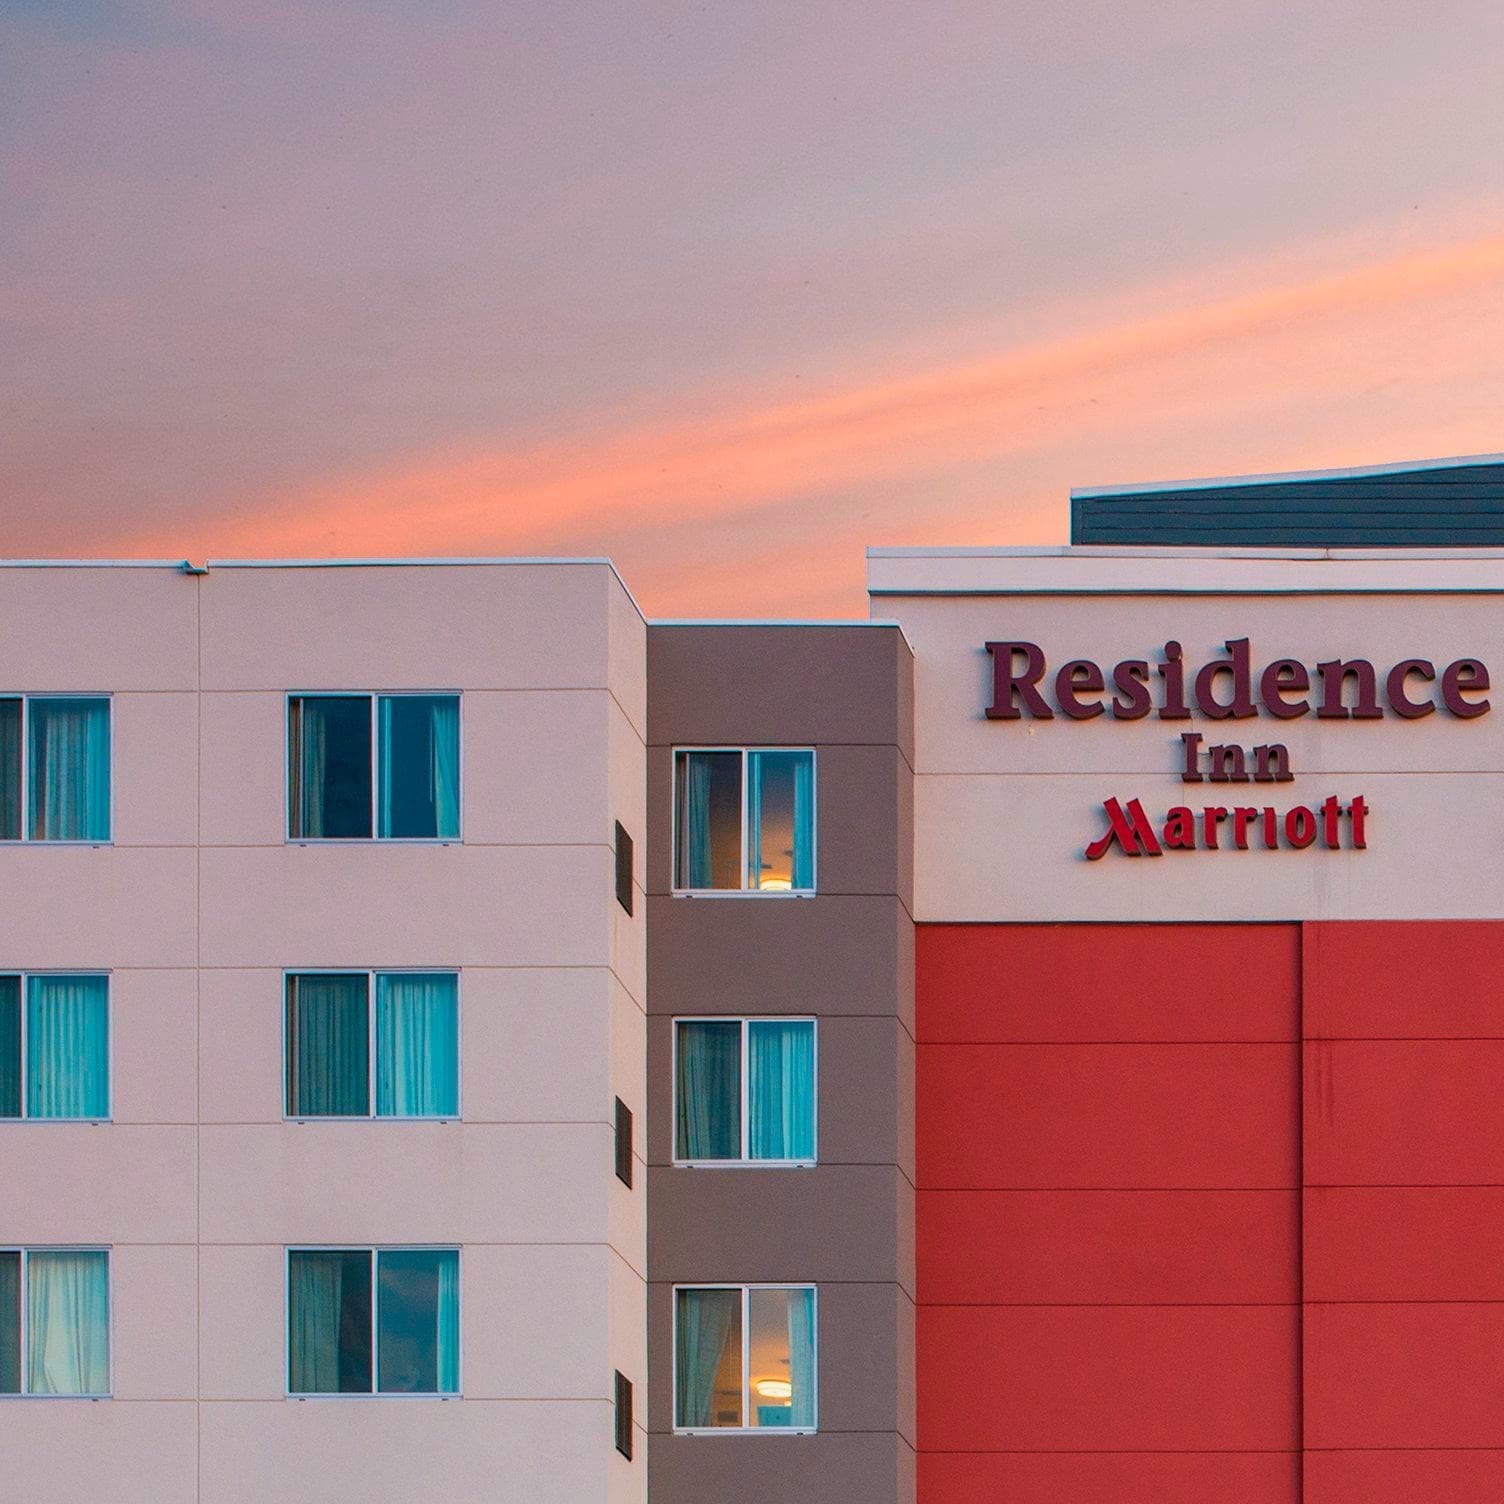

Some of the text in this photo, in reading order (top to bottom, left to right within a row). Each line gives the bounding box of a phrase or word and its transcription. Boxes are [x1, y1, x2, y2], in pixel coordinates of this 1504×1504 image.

[983, 638, 1491, 719] Residence
[1180, 733, 1295, 782] Inn
[1085, 796, 1369, 860] Marriott
